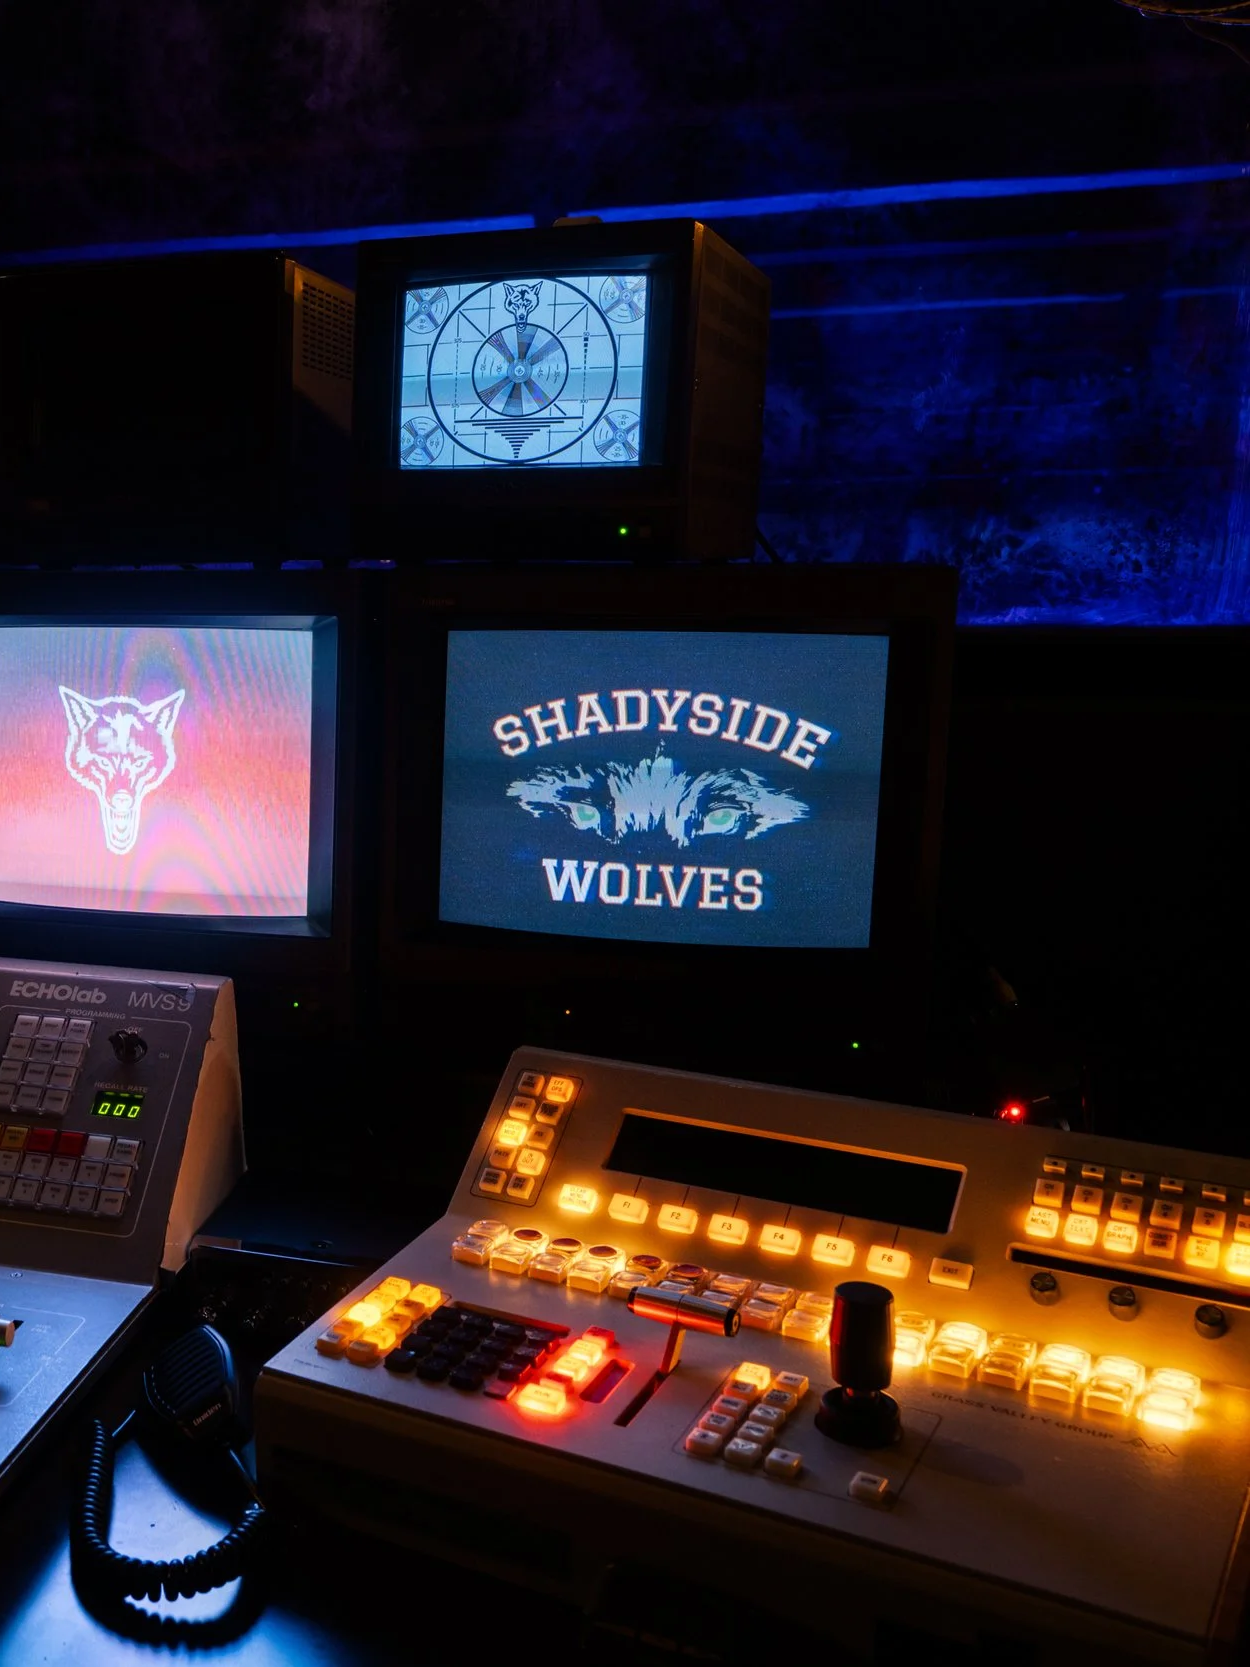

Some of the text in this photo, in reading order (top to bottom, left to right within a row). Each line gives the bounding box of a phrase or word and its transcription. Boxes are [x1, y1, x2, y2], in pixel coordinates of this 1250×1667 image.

[492, 688, 832, 770] SHADYSIDE
[542, 858, 764, 911] WOLVES
[9, 980, 107, 1005] ECHOlab
[65, 1008, 127, 1020] PROGRAMMING
[98, 1102, 141, 1118] 000
[622, 1199, 630, 1209] F1
[670, 1210, 681, 1220] F2
[721, 1221, 732, 1231] F3
[1030, 1218, 1051, 1227] MENU
[773, 1231, 784, 1241] F4
[826, 1242, 837, 1251] F5
[881, 1253, 893, 1263] F6
[931, 1391, 1114, 1440] GRASS VALLEY GROUP
